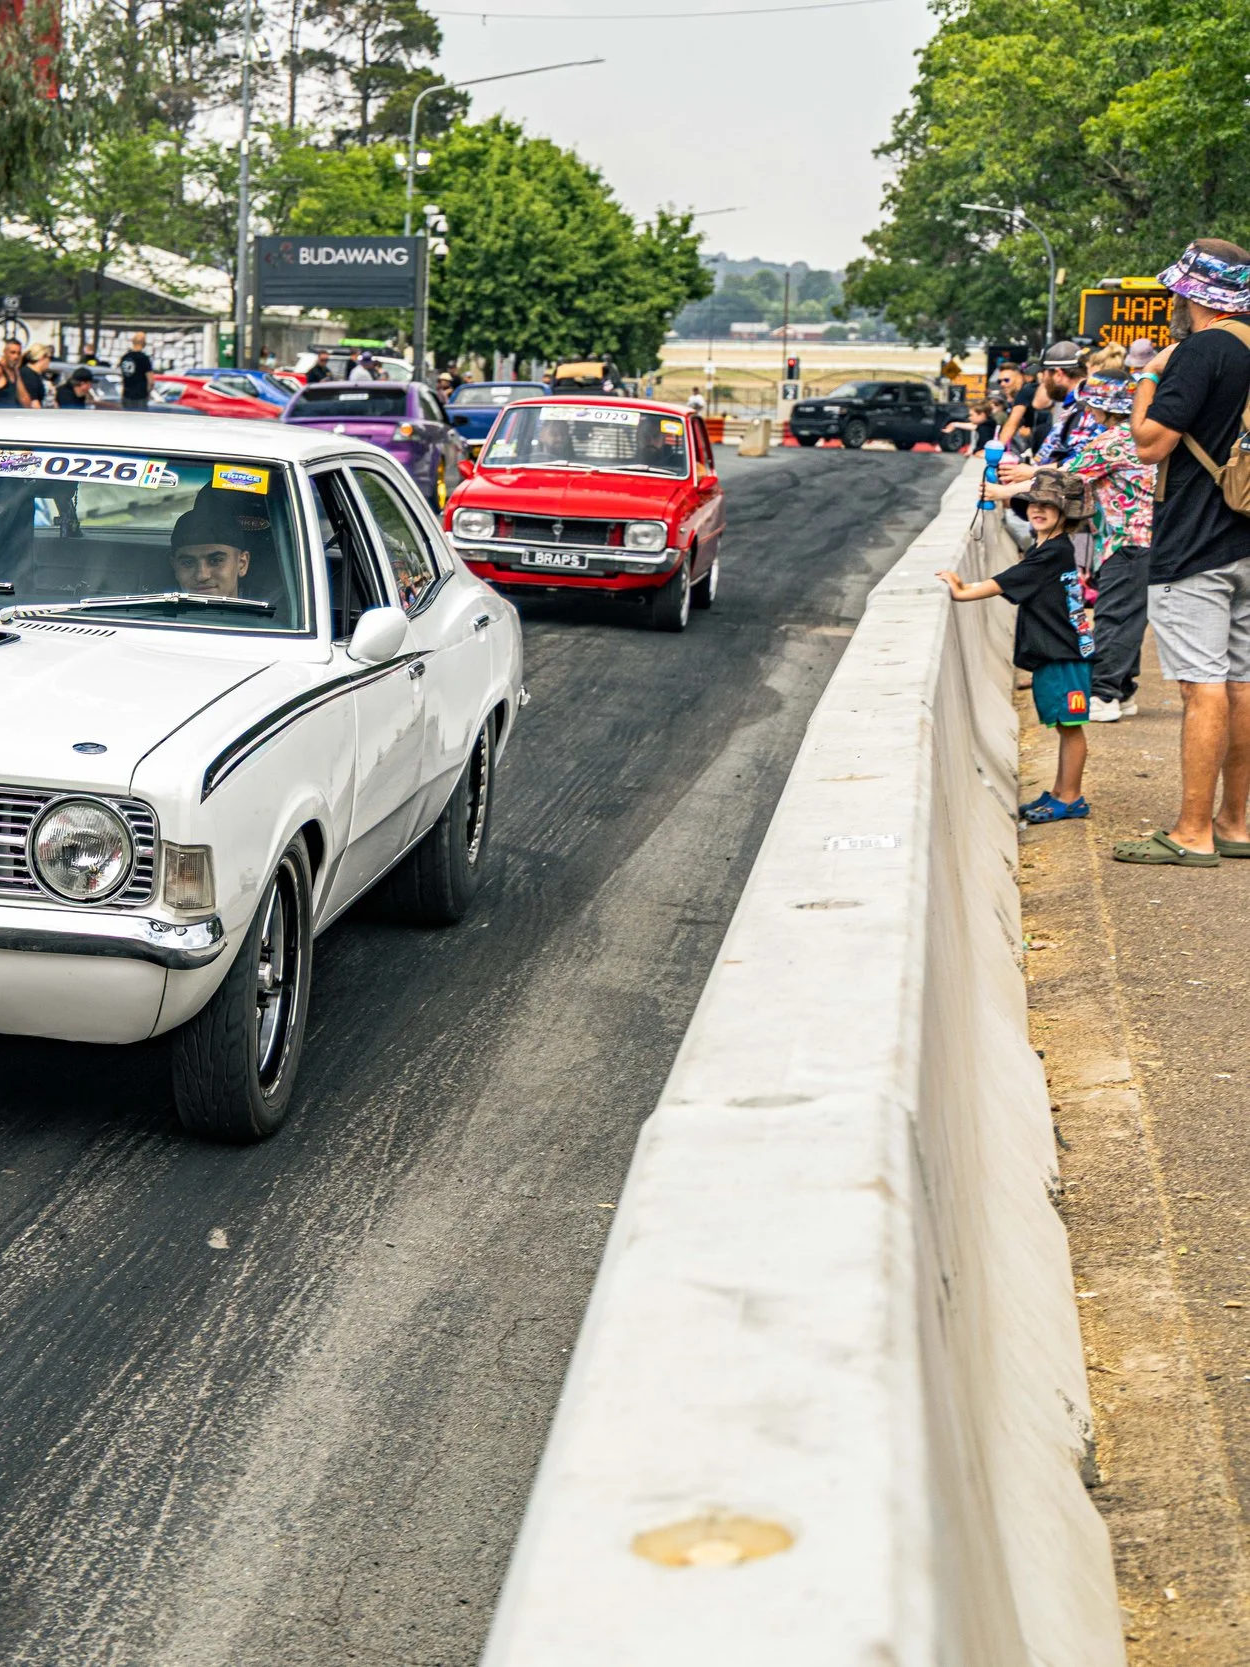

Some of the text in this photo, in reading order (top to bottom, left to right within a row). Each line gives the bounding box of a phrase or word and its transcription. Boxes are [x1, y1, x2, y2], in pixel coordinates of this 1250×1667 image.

[299, 247, 409, 266] BUDAWANG
[1098, 325, 1175, 347] SUMMER
[44, 456, 138, 481] 0226
[535, 551, 580, 567] BRAPS
